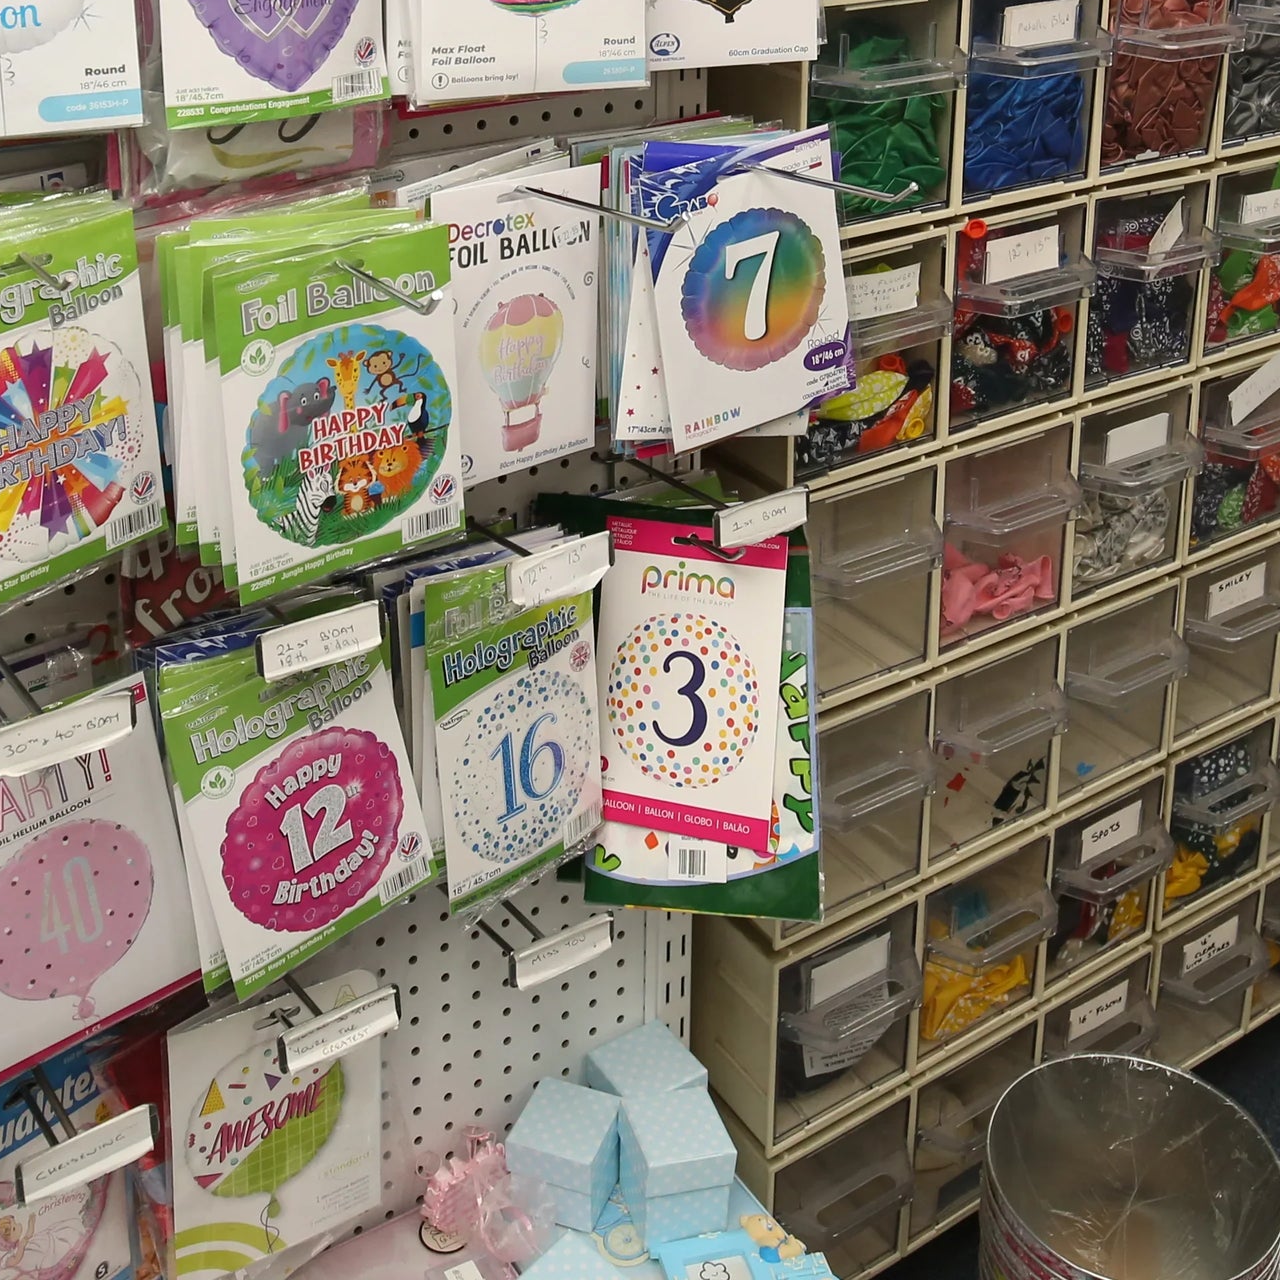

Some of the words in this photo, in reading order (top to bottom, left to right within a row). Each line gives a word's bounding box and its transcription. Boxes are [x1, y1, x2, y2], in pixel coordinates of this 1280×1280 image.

[431, 45, 457, 56] Max
[459, 43, 486, 54] Float
[603, 35, 636, 47] Round
[728, 47, 749, 57] 60cm
[750, 46, 786, 56] Graduation
[788, 44, 809, 56] Cap
[84, 64, 126, 77] Round
[431, 56, 453, 67] Foil
[455, 53, 496, 65] Balloon
[175, 91, 224, 103] 18"/45.7cm
[451, 74, 483, 85] Balloons
[484, 74, 503, 84] bring
[504, 73, 519, 83] Joy!
[210, 99, 268, 115] Congratulations
[269, 95, 311, 109] Engagement
[448, 210, 536, 244] Decrotex
[240, 296, 297, 337] Foil
[306, 268, 436, 309] Balloon
[724, 230, 781, 341] 7
[48, 283, 124, 329] Balloon
[808, 328, 839, 349] Round
[312, 402, 389, 441] HAPPY
[684, 405, 742, 434] RAINBOW
[298, 422, 407, 473] BIRTHDAY
[4, 578, 19, 589] Star
[21, 565, 50, 582] Birthday
[281, 564, 306, 582] Jungle
[306, 556, 326, 573] Happy
[326, 546, 354, 565] Birthday
[641, 560, 736, 601] prima
[1218, 571, 1253, 592] SMILEY
[442, 604, 578, 688] Holographic
[528, 628, 580, 671] Balloon
[188, 653, 370, 766] Holographic
[306, 679, 374, 733] Balloon
[652, 650, 708, 747] 3
[264, 752, 343, 809] Happy
[489, 712, 566, 824] 16
[12, 820, 48, 841] HELIUM
[49, 797, 92, 823] BALLOON
[645, 806, 674, 819] BALLON
[684, 813, 713, 827] GLOBO
[723, 819, 750, 835] BALÃO
[1091, 822, 1121, 843] SPOTS
[272, 831, 380, 907] Birthday!
[39, 854, 107, 956] 40
[206, 1070, 332, 1166] AWESOME
[38, 1190, 86, 1217] Christening
